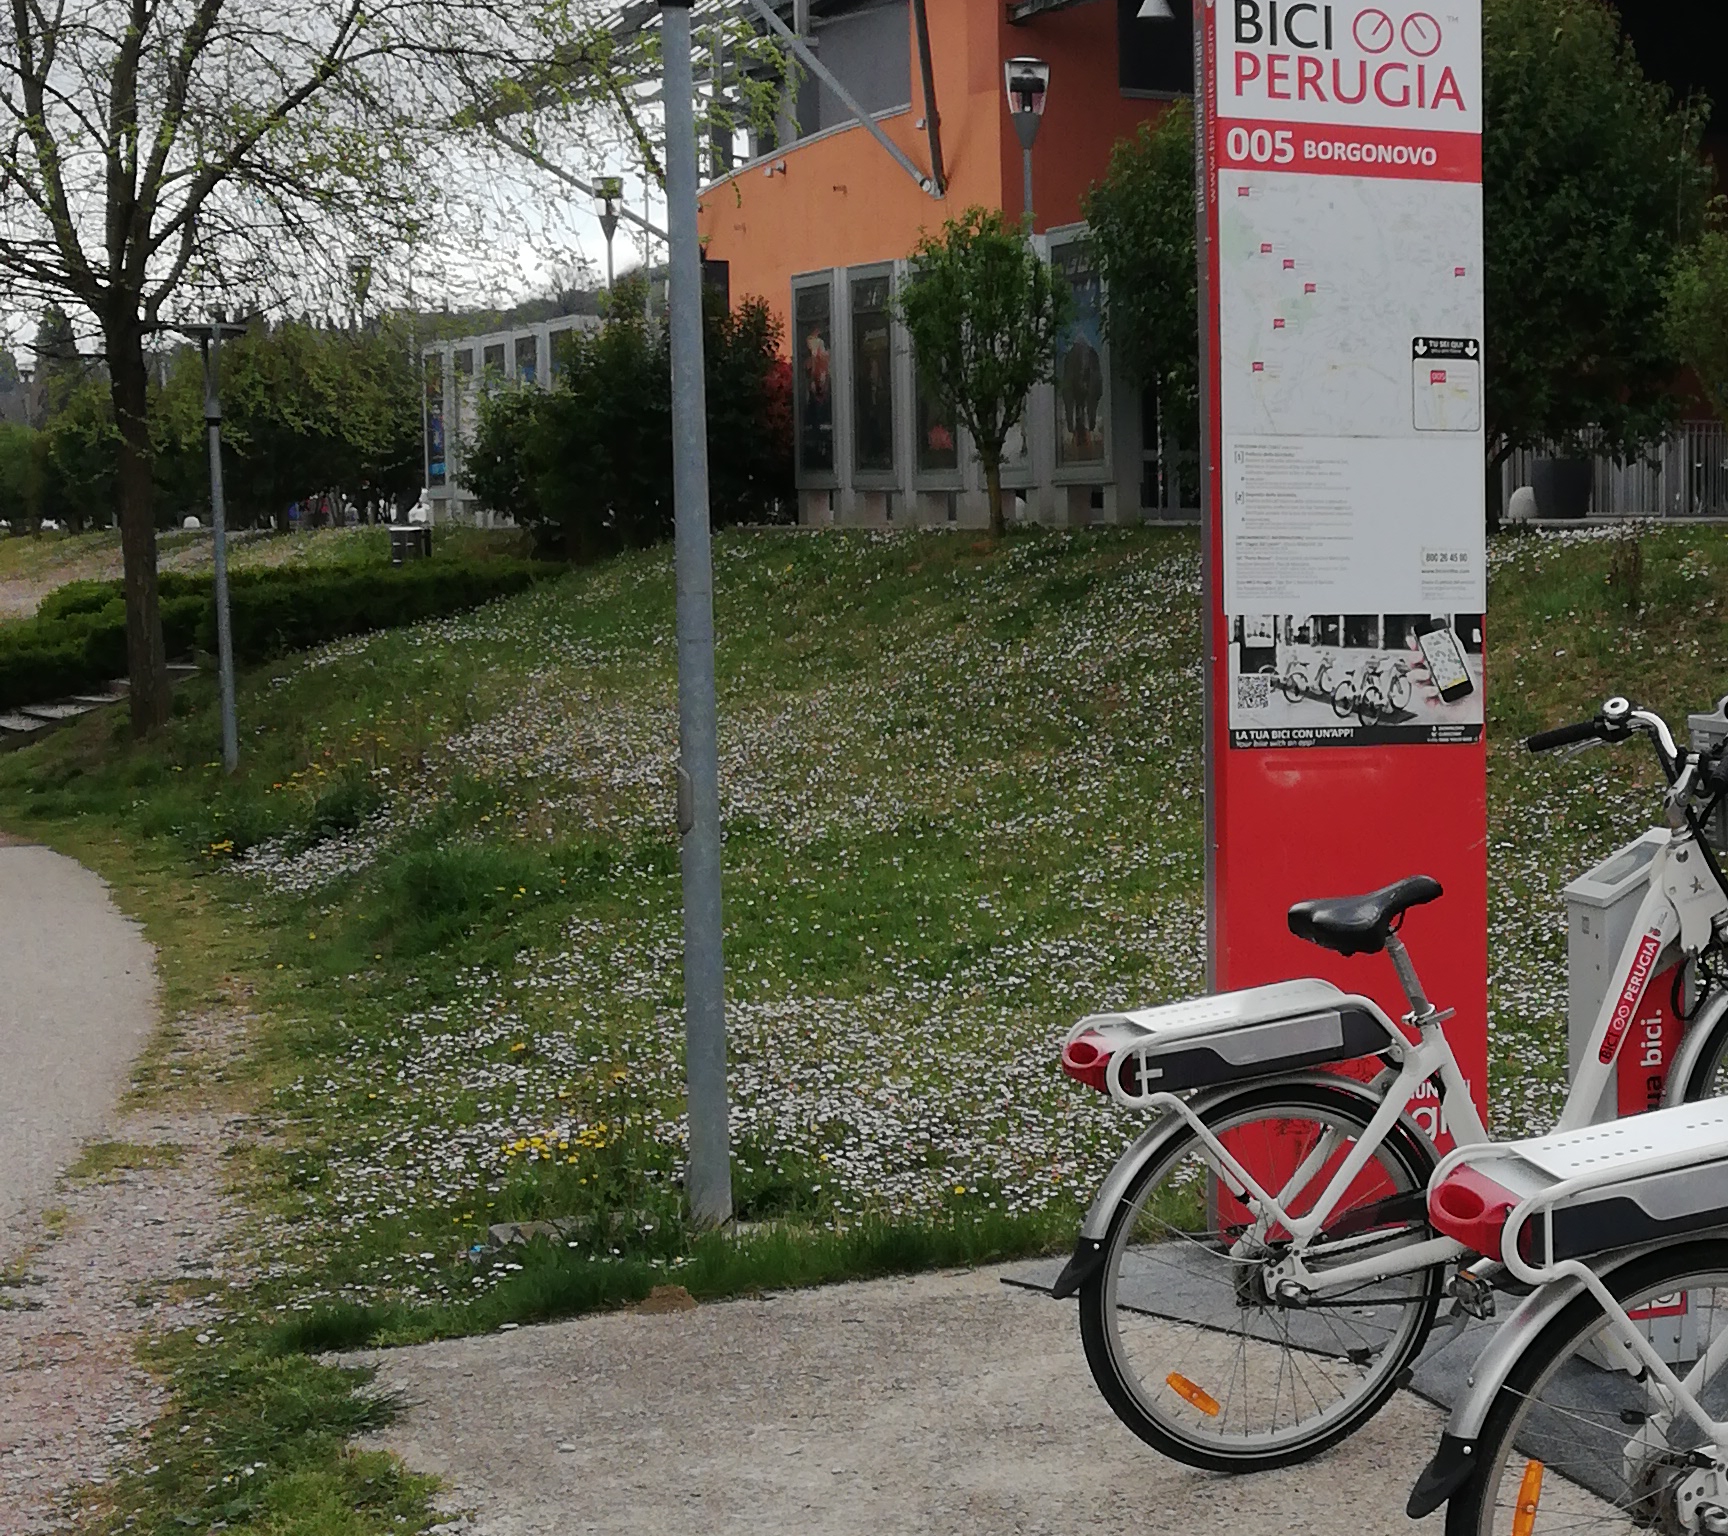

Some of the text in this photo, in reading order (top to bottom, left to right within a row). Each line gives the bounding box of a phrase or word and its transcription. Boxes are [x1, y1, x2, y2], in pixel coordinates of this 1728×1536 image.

[1193, 29, 1204, 98] Perugia
[1234, 50, 1467, 112] PERUGIA
[1226, 127, 1437, 166] 005 BORGONOVO
[1429, 340, 1438, 348] TU
[1451, 341, 1464, 349] QUI
[1235, 728, 1354, 740] LA TUA BICI CON UN'APP!
[1601, 940, 1658, 1060] BICI PERUGIA
[1640, 1009, 1663, 1067] bici.
